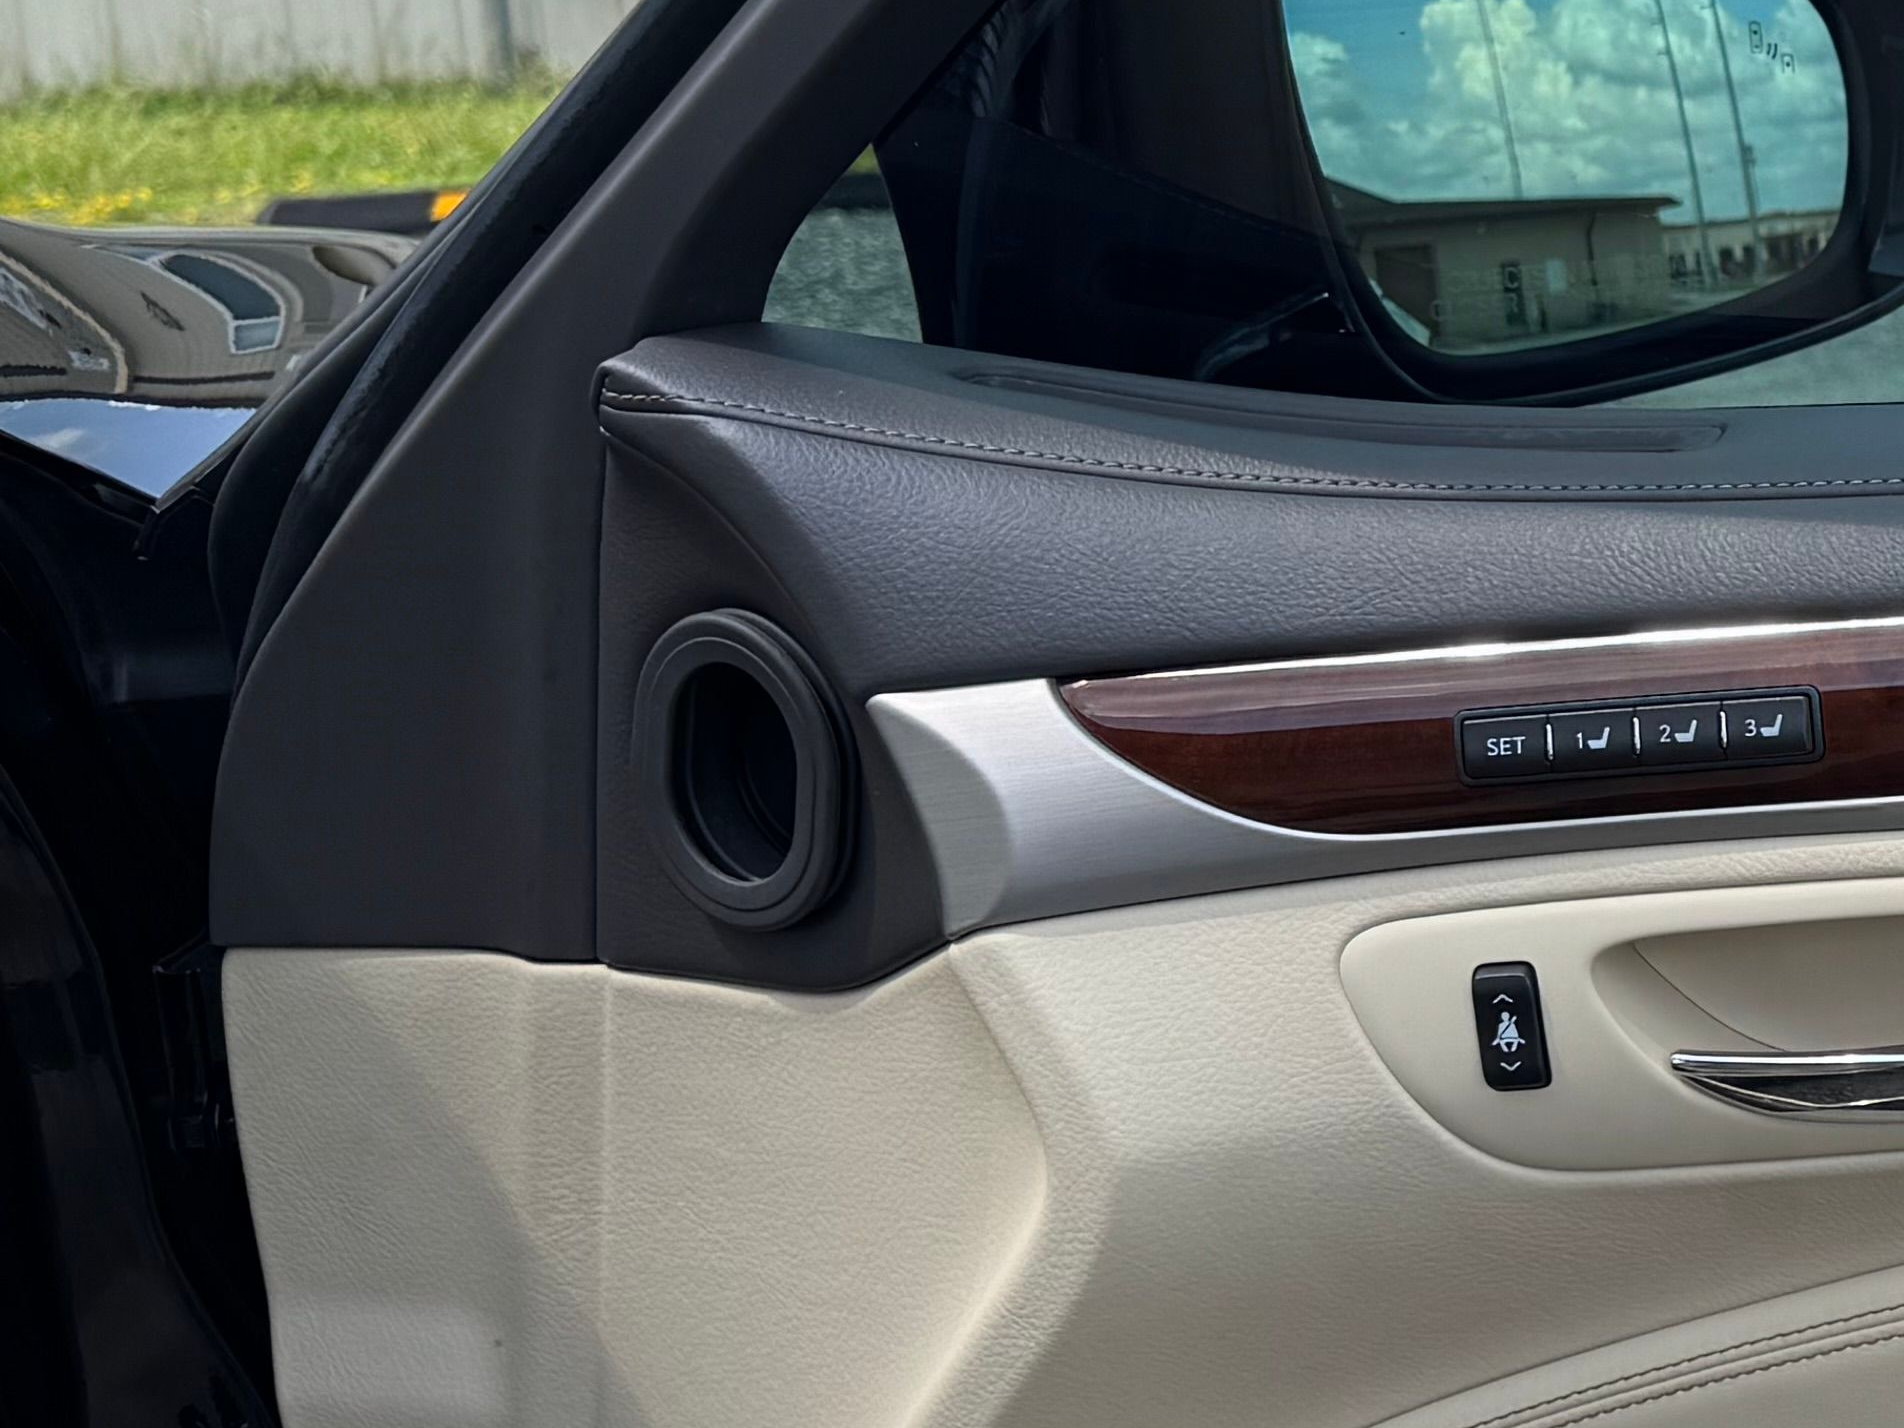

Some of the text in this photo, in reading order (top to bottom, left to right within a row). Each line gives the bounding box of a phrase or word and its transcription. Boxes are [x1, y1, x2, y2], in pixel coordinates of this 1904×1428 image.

[1487, 719, 1757, 756] SET 1 2 3
